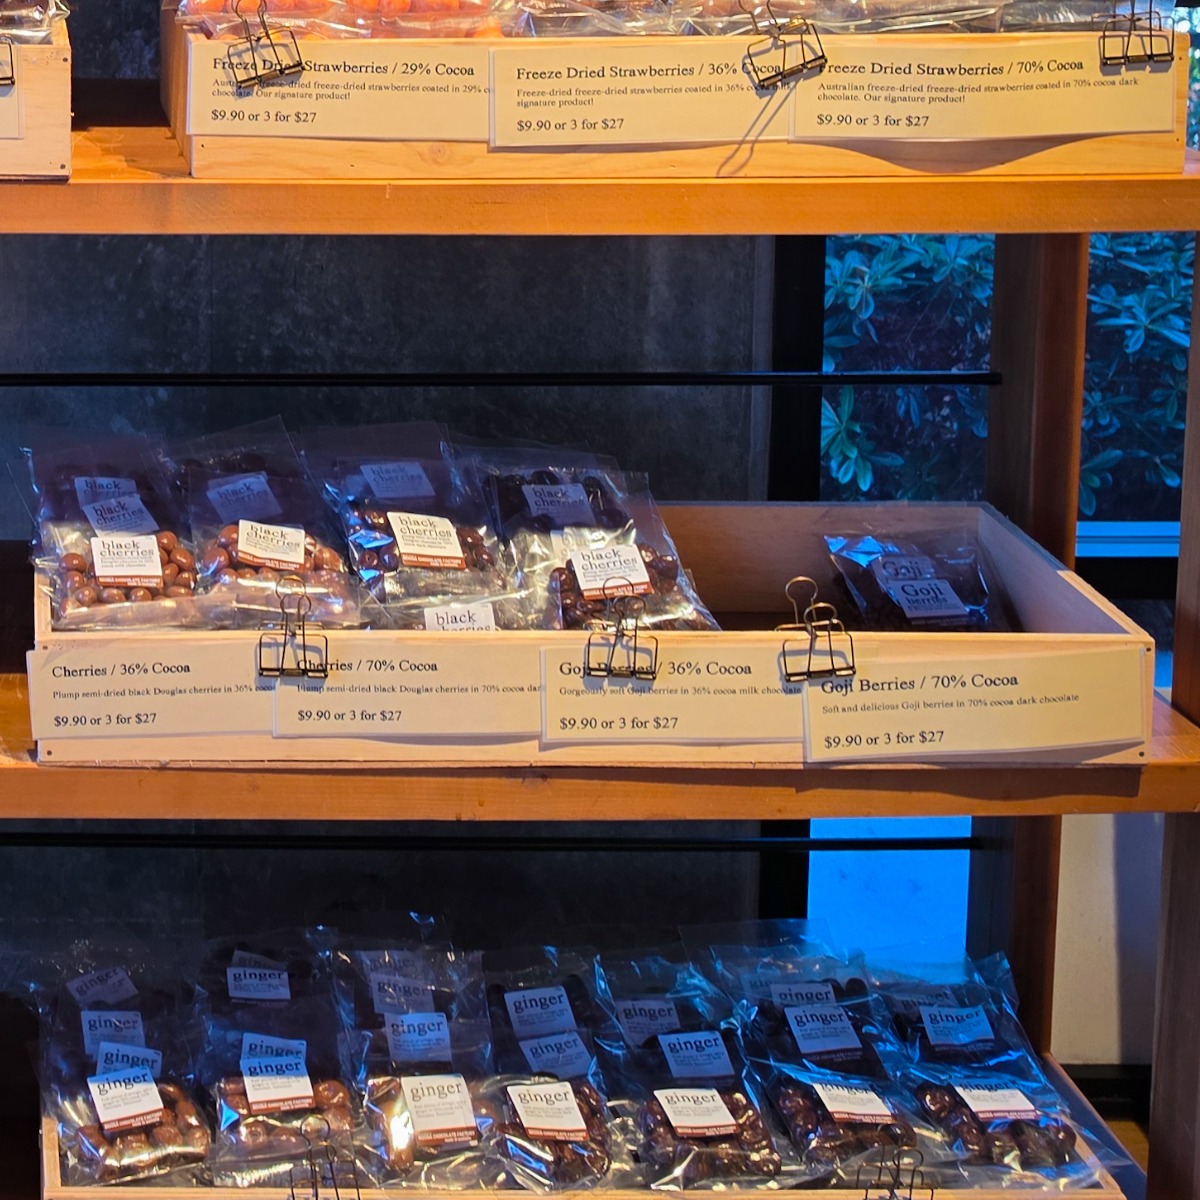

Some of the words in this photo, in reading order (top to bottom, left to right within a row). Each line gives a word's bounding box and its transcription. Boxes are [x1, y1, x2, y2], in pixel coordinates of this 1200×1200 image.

[516, 67, 562, 80] Freeze
[566, 65, 605, 78] Dried
[609, 63, 694, 78] Strawberries
[698, 63, 704, 75] /
[708, 62, 737, 75] 36%
[870, 62, 912, 75] Dried
[916, 62, 1004, 75] Strawberries
[1007, 61, 1013, 74] /
[1016, 60, 1043, 73] 70%
[1047, 59, 1084, 72] Cocoa
[516, 119, 551, 132] $9.90
[554, 122, 567, 130] or
[570, 119, 577, 130] 3
[581, 118, 598, 130] for
[601, 118, 624, 130] $27
[100, 548, 154, 558] cherries
[102, 540, 141, 550] black
[52, 664, 107, 678] Cherries
[110, 664, 116, 675] /
[120, 663, 148, 675] 36%
[152, 662, 191, 674] Cocoa
[820, 678, 854, 696] Goji
[859, 676, 915, 692] Berries
[920, 675, 926, 689] /
[931, 674, 966, 688] 70%
[971, 673, 1019, 687] Cocoa
[53, 715, 87, 727] $9.90
[89, 717, 102, 725] or
[105, 714, 112, 725] 3
[116, 713, 132, 724] for
[134, 712, 156, 724] $27
[824, 734, 862, 749] $9.90
[865, 736, 879, 745] or
[883, 732, 891, 744] 3
[896, 731, 915, 744] for
[918, 730, 944, 744] $27
[233, 969, 285, 982] ginger
[391, 1020, 444, 1037] ginger
[668, 1034, 720, 1053] ginger
[410, 1082, 462, 1102] ginger
[518, 1089, 571, 1106] ginger
